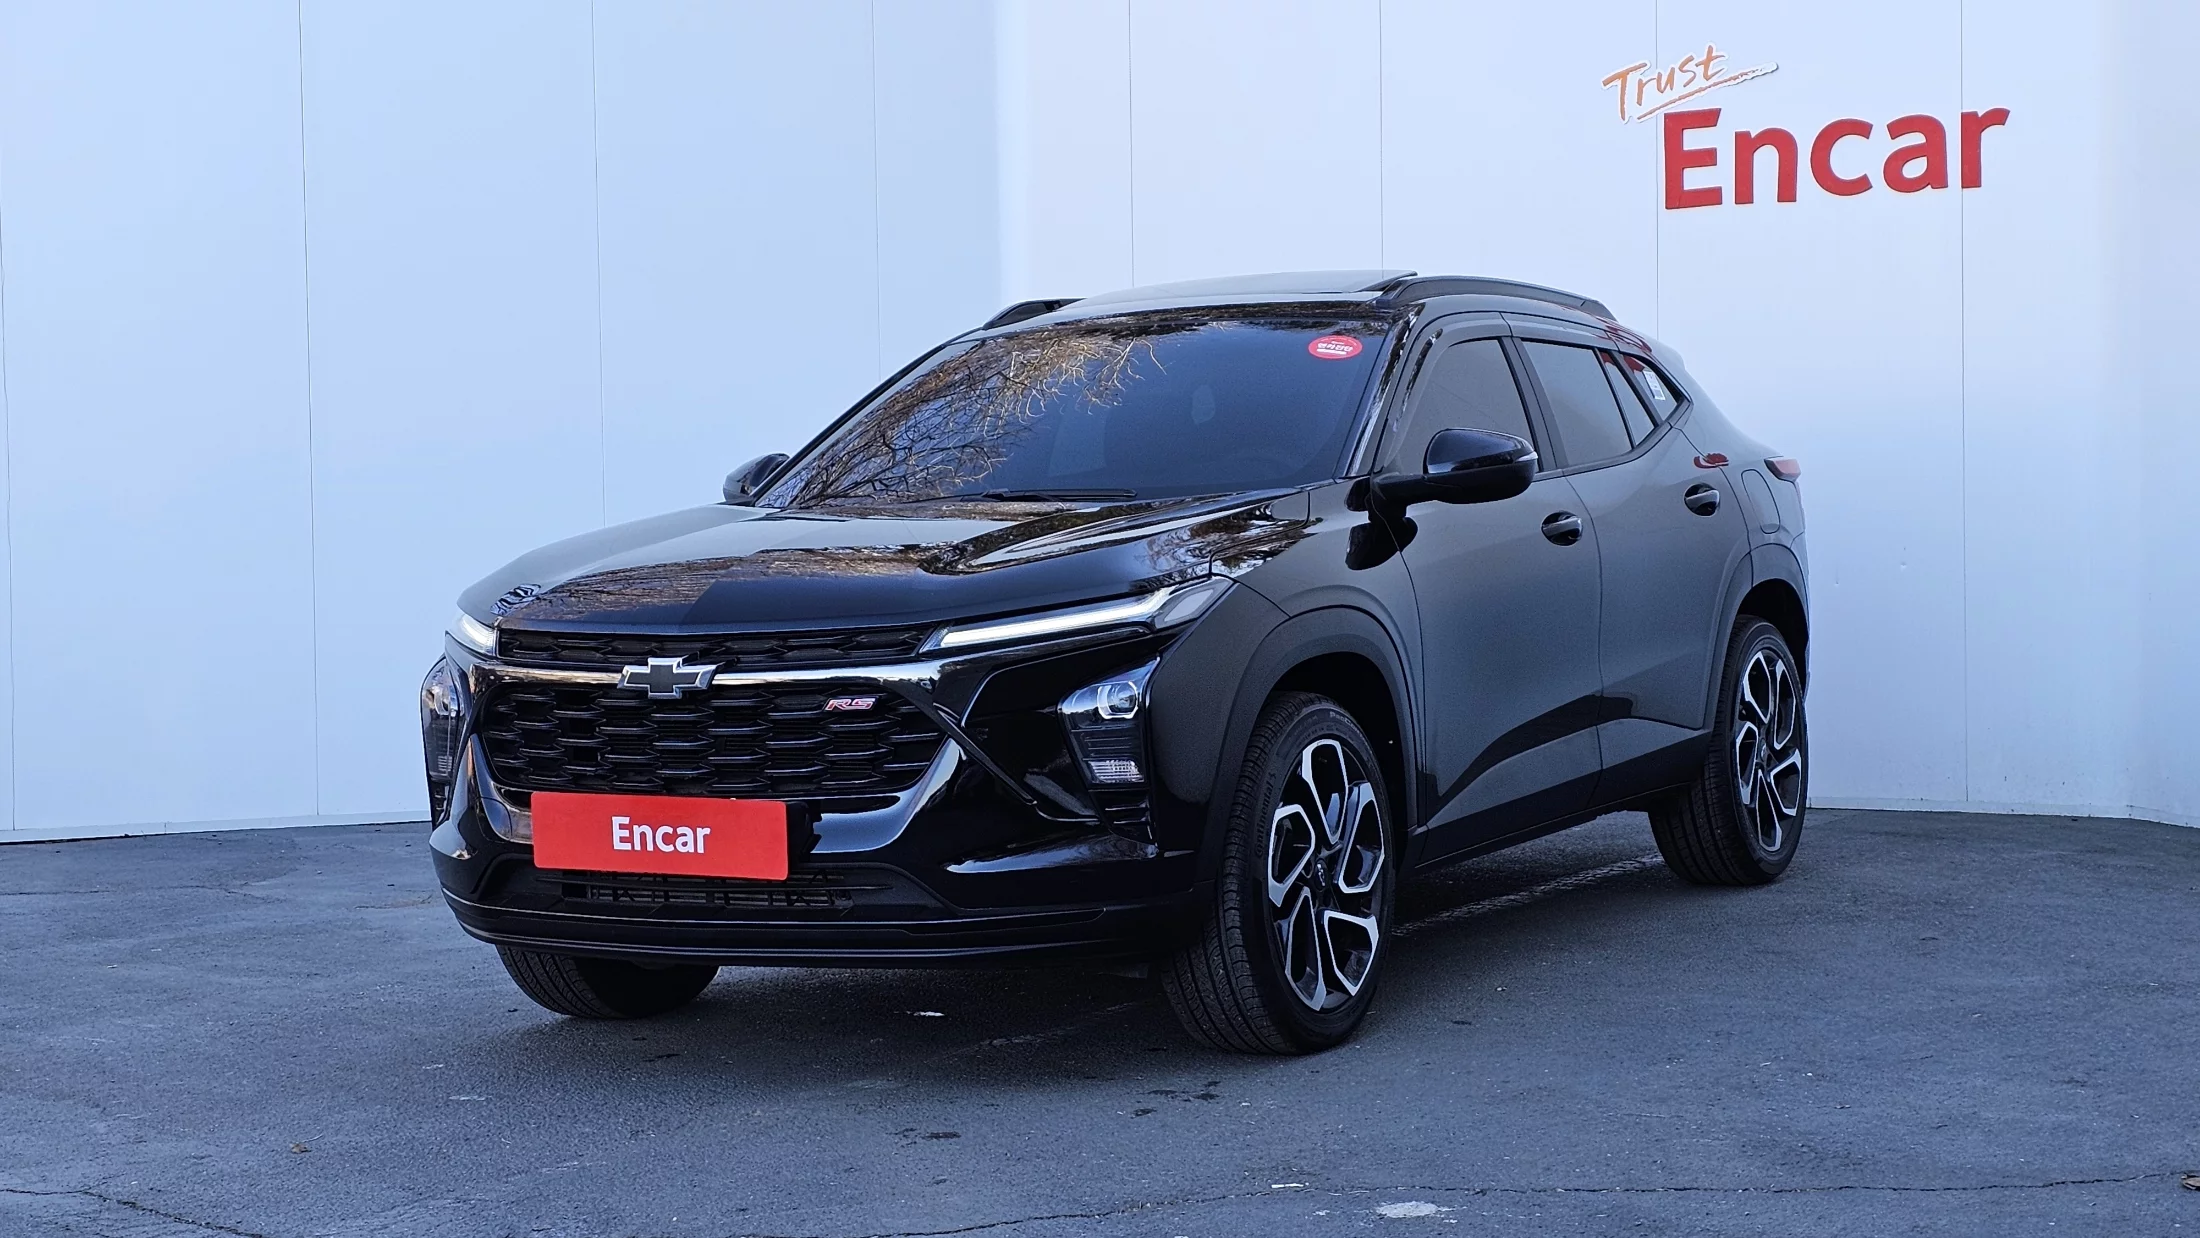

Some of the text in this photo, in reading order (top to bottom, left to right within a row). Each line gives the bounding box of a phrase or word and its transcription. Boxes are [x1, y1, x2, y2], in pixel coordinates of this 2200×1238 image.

[1602, 45, 1728, 120] Trust
[1664, 107, 2011, 210] Encar
[825, 698, 876, 711] RS
[611, 816, 711, 853] Encar
